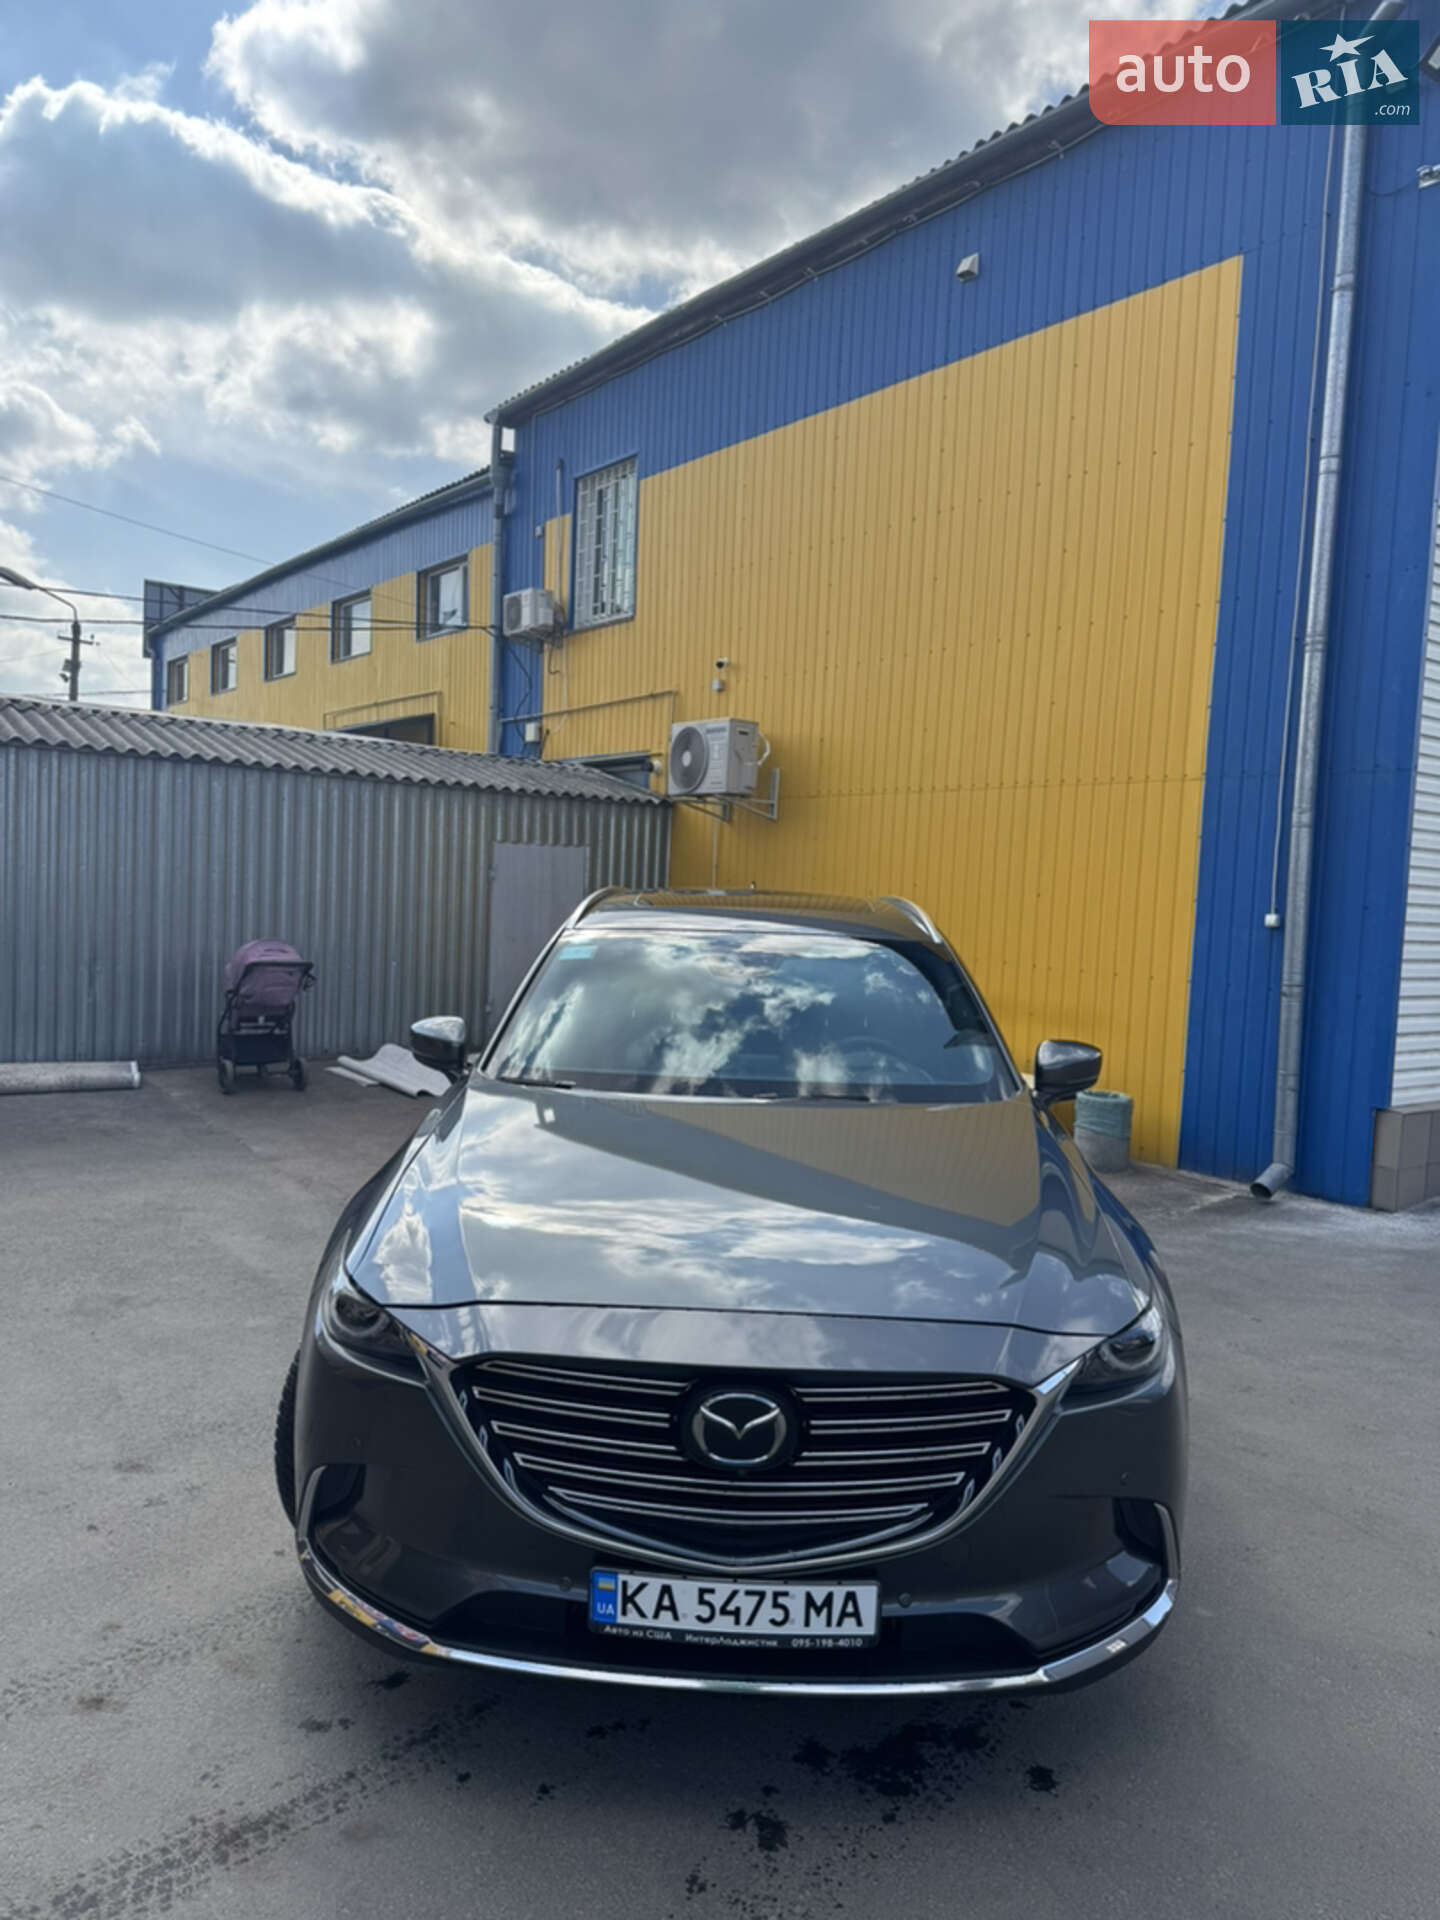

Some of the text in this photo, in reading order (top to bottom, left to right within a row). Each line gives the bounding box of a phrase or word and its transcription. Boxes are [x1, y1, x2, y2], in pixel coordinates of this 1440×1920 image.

[597, 1602, 615, 1616] UA
[621, 1580, 864, 1628] KA 5475 MA
[604, 1625, 630, 1636] Авто
[632, 1629, 644, 1637] из
[646, 1629, 673, 1640] США
